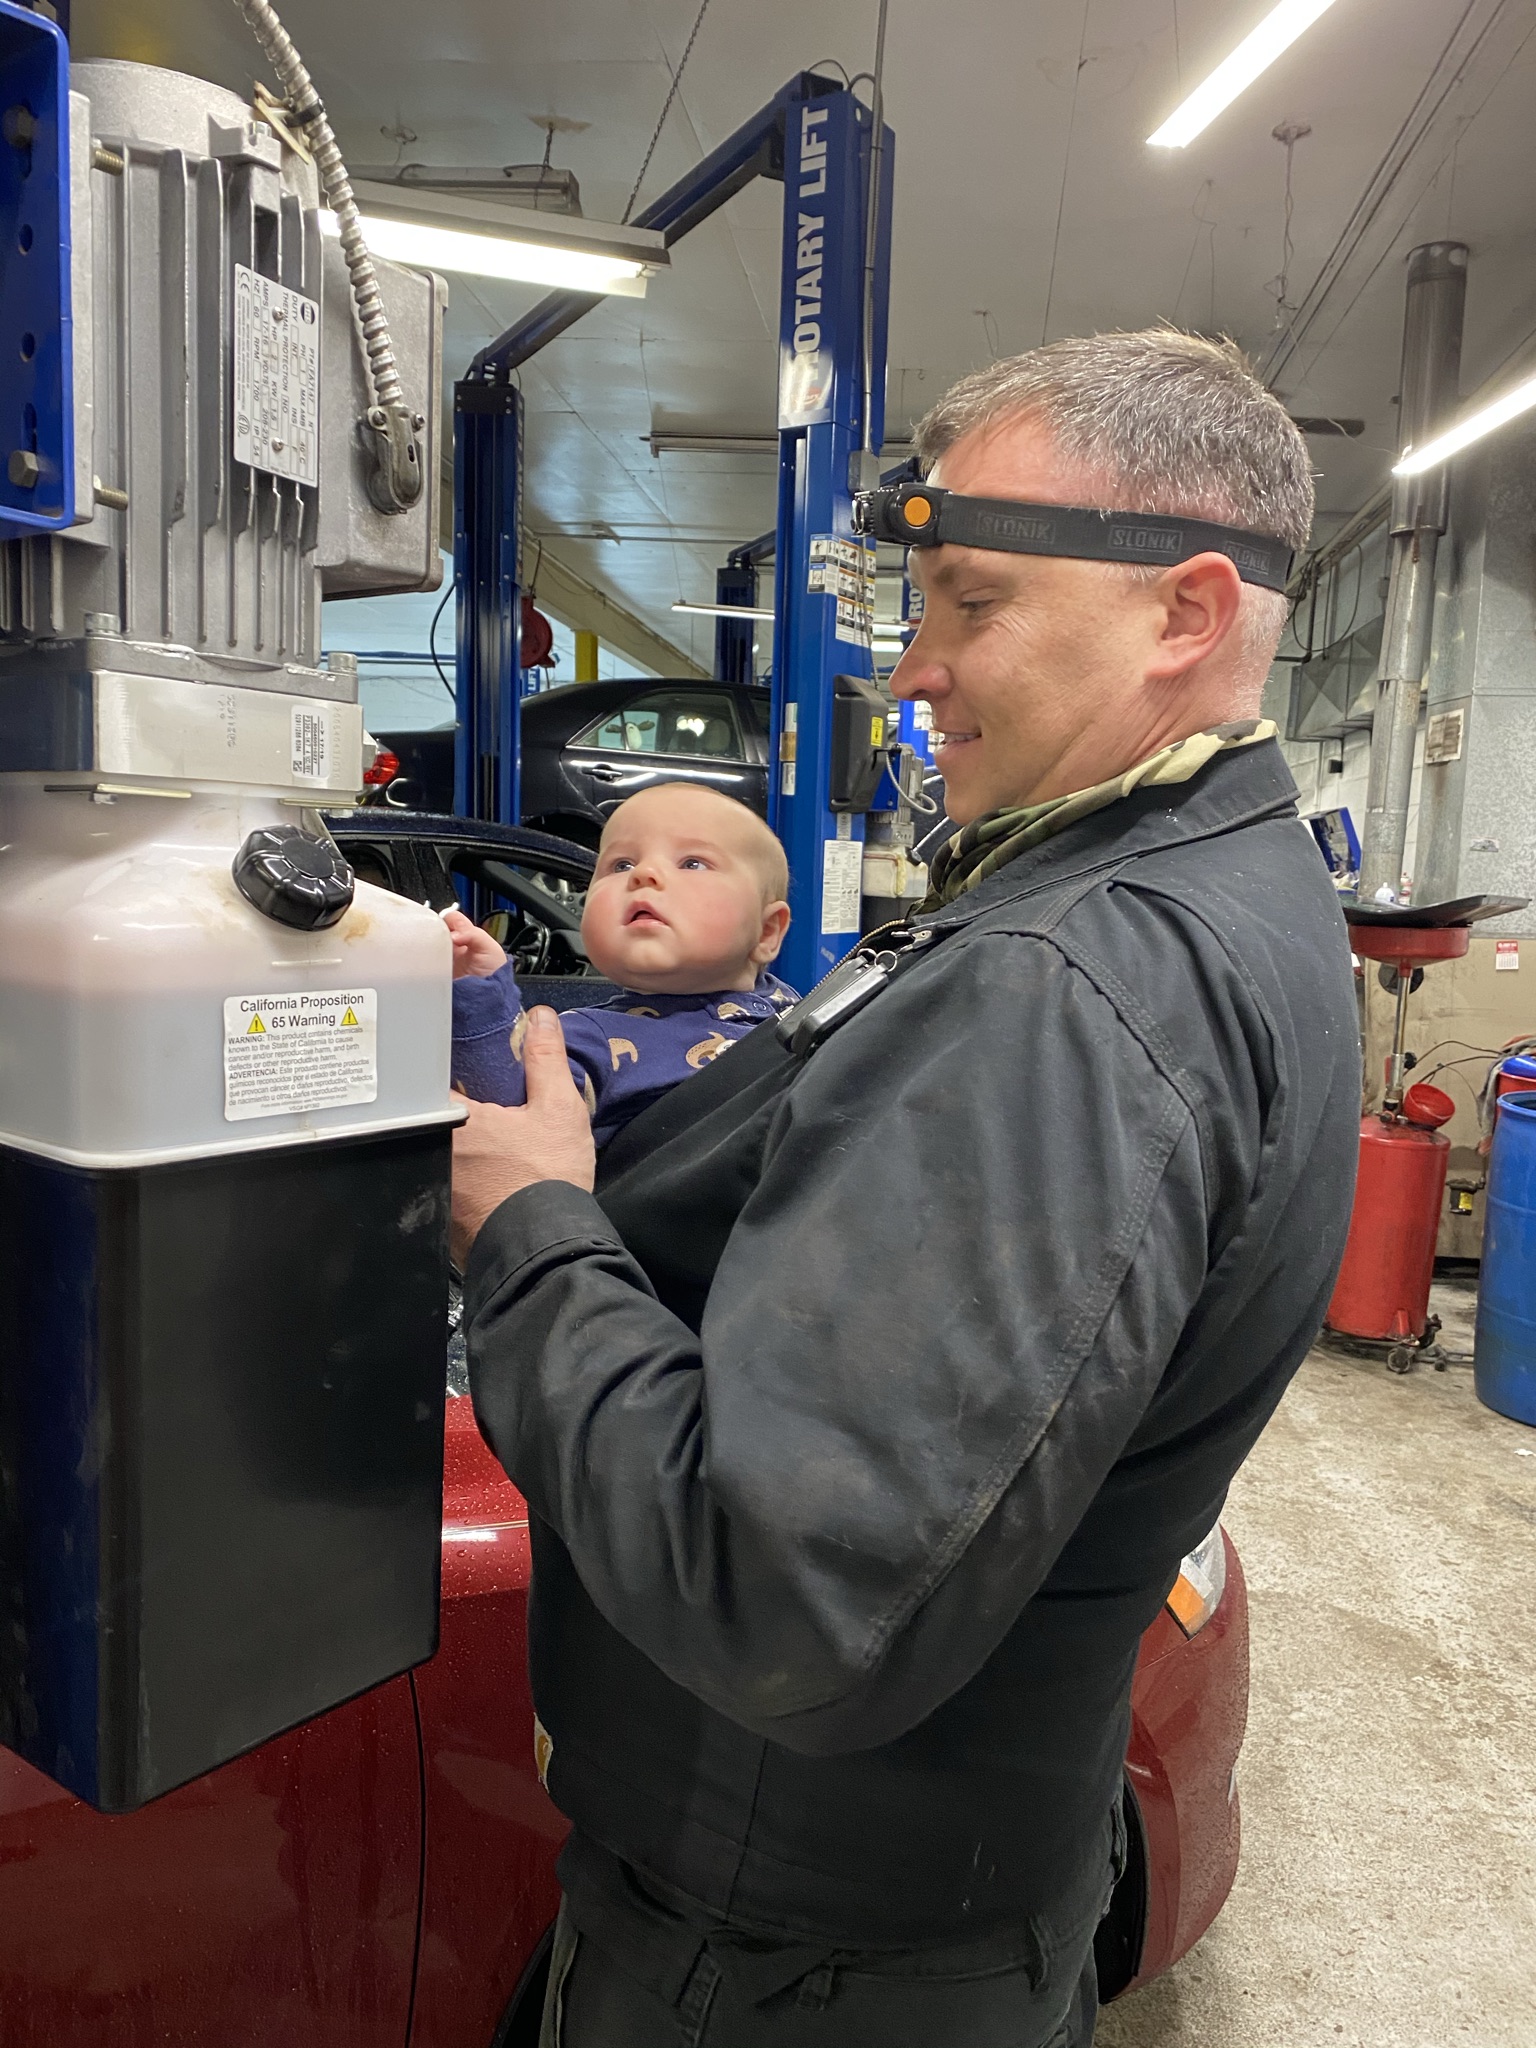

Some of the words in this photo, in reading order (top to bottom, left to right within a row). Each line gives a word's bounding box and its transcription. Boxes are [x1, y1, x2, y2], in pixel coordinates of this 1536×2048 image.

[799, 106, 828, 198] LIFT
[254, 279, 260, 293] HZ
[793, 212, 824, 381] ROTARY
[254, 306, 259, 318] 60
[272, 326, 277, 340] HP
[300, 344, 306, 356] PH
[272, 381, 277, 397] KW
[282, 398, 288, 414] NO
[254, 425, 259, 436] IP
[980, 515, 1052, 541] SLONIK
[1113, 528, 1178, 550] SLONIK
[240, 998, 297, 1012] California
[301, 994, 364, 1010] Proposition
[272, 1016, 286, 1028] 65
[289, 1014, 336, 1027] Warning
[228, 1035, 265, 1044] WARNING:
[282, 1032, 307, 1041] product
[308, 1030, 332, 1038] contains
[334, 1027, 363, 1035] chemicals
[228, 1054, 251, 1062] cancer
[275, 1048, 313, 1059] reproductive
[229, 1045, 250, 1053] known
[229, 1063, 252, 1071] defects
[281, 1056, 319, 1066] reproductive
[229, 1069, 277, 1079] ADVERTENCIA:
[295, 1064, 318, 1073] producto
[343, 1060, 369, 1068] productos
[257, 1076, 291, 1084] reconocidos
[310, 1071, 328, 1079] estado
[241, 1088, 269, 1096] provocan
[238, 1096, 270, 1104] nacimiento
